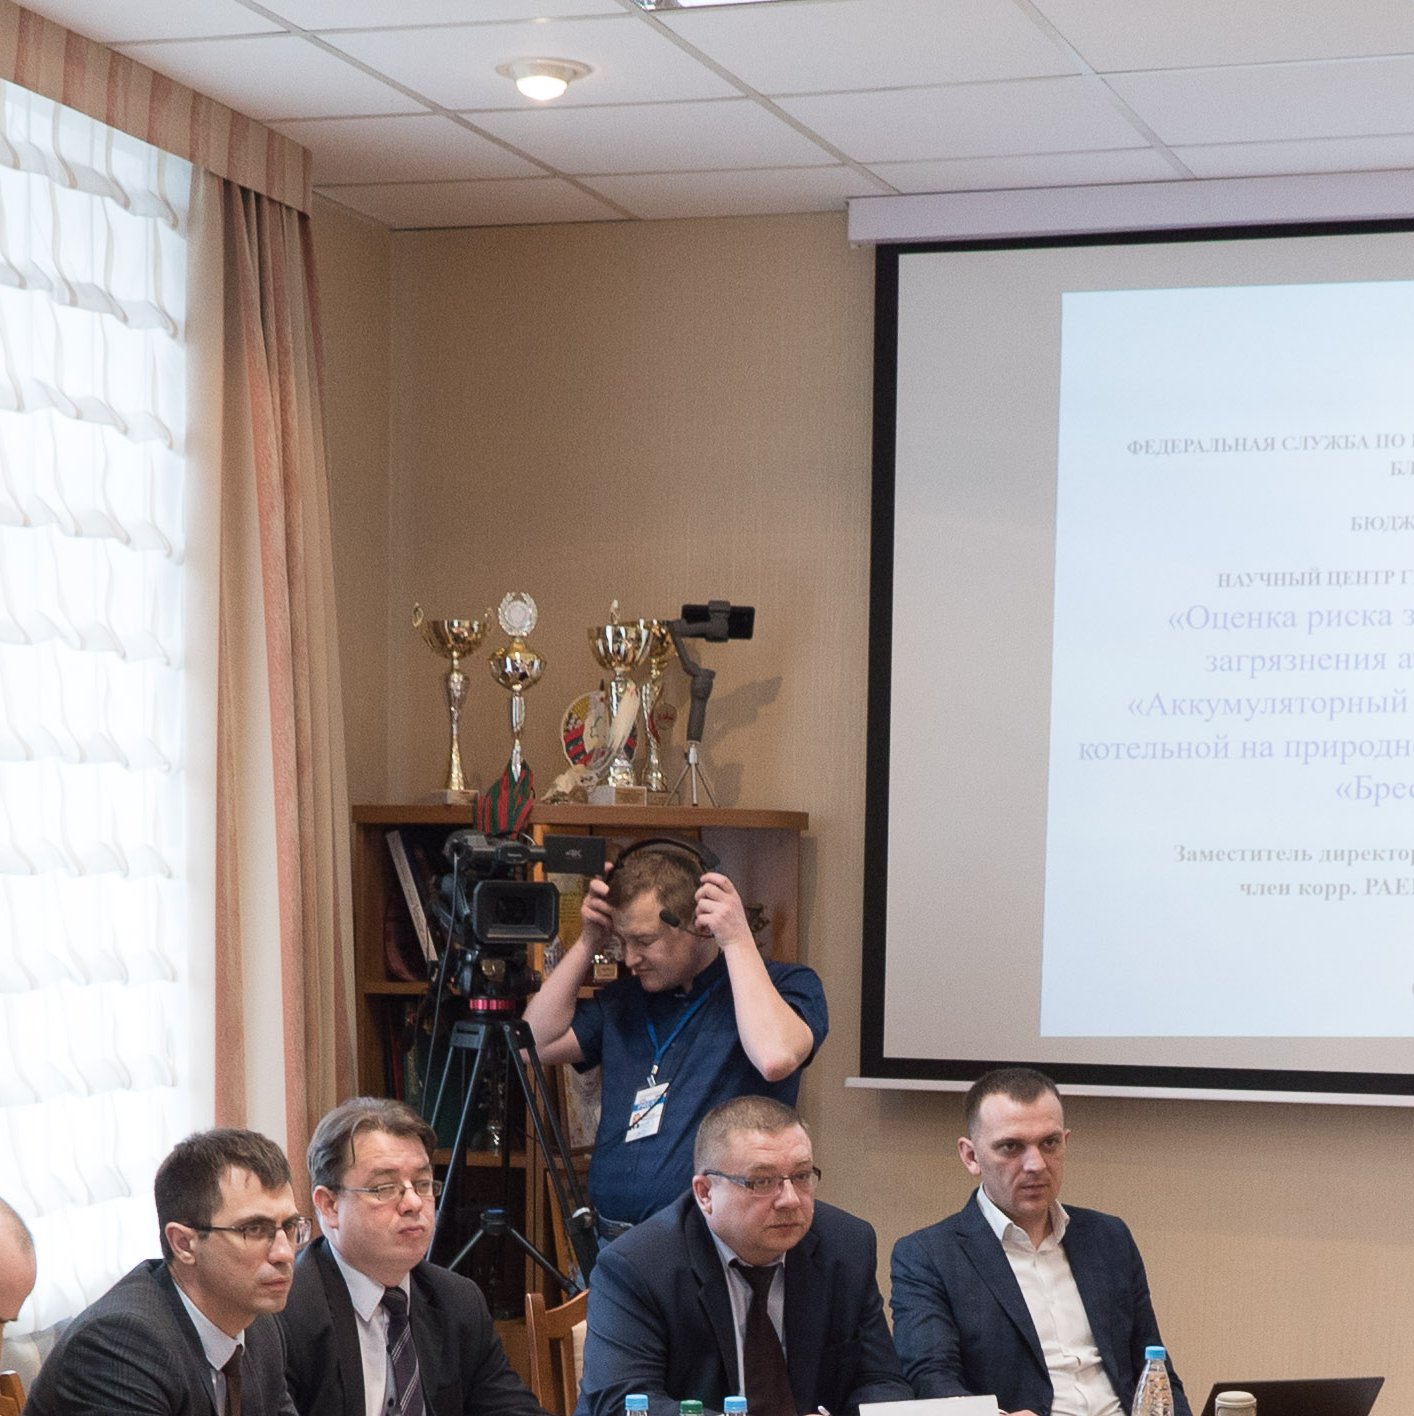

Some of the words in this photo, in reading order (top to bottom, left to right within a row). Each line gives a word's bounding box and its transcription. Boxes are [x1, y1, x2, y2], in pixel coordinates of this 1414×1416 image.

[1125, 435, 1278, 458] ФЕДЕРАЛЬНАЯ
[1280, 433, 1371, 453] СЛУЖБА
[1373, 432, 1407, 451] ПО
[1216, 566, 1323, 590] НАУЧНЫЙ
[1325, 568, 1397, 590] ЦЕНТР
[1166, 604, 1298, 633] «Оценка
[1306, 608, 1394, 637] риска
[1204, 651, 1388, 681] загрязнения
[1127, 687, 1408, 725] «Аккумуляторный
[1078, 733, 1230, 762] котельной
[1239, 739, 1275, 760] на
[1173, 843, 1314, 863] Заместитель
[1238, 882, 1292, 897] член
[1297, 882, 1358, 903] корр.
